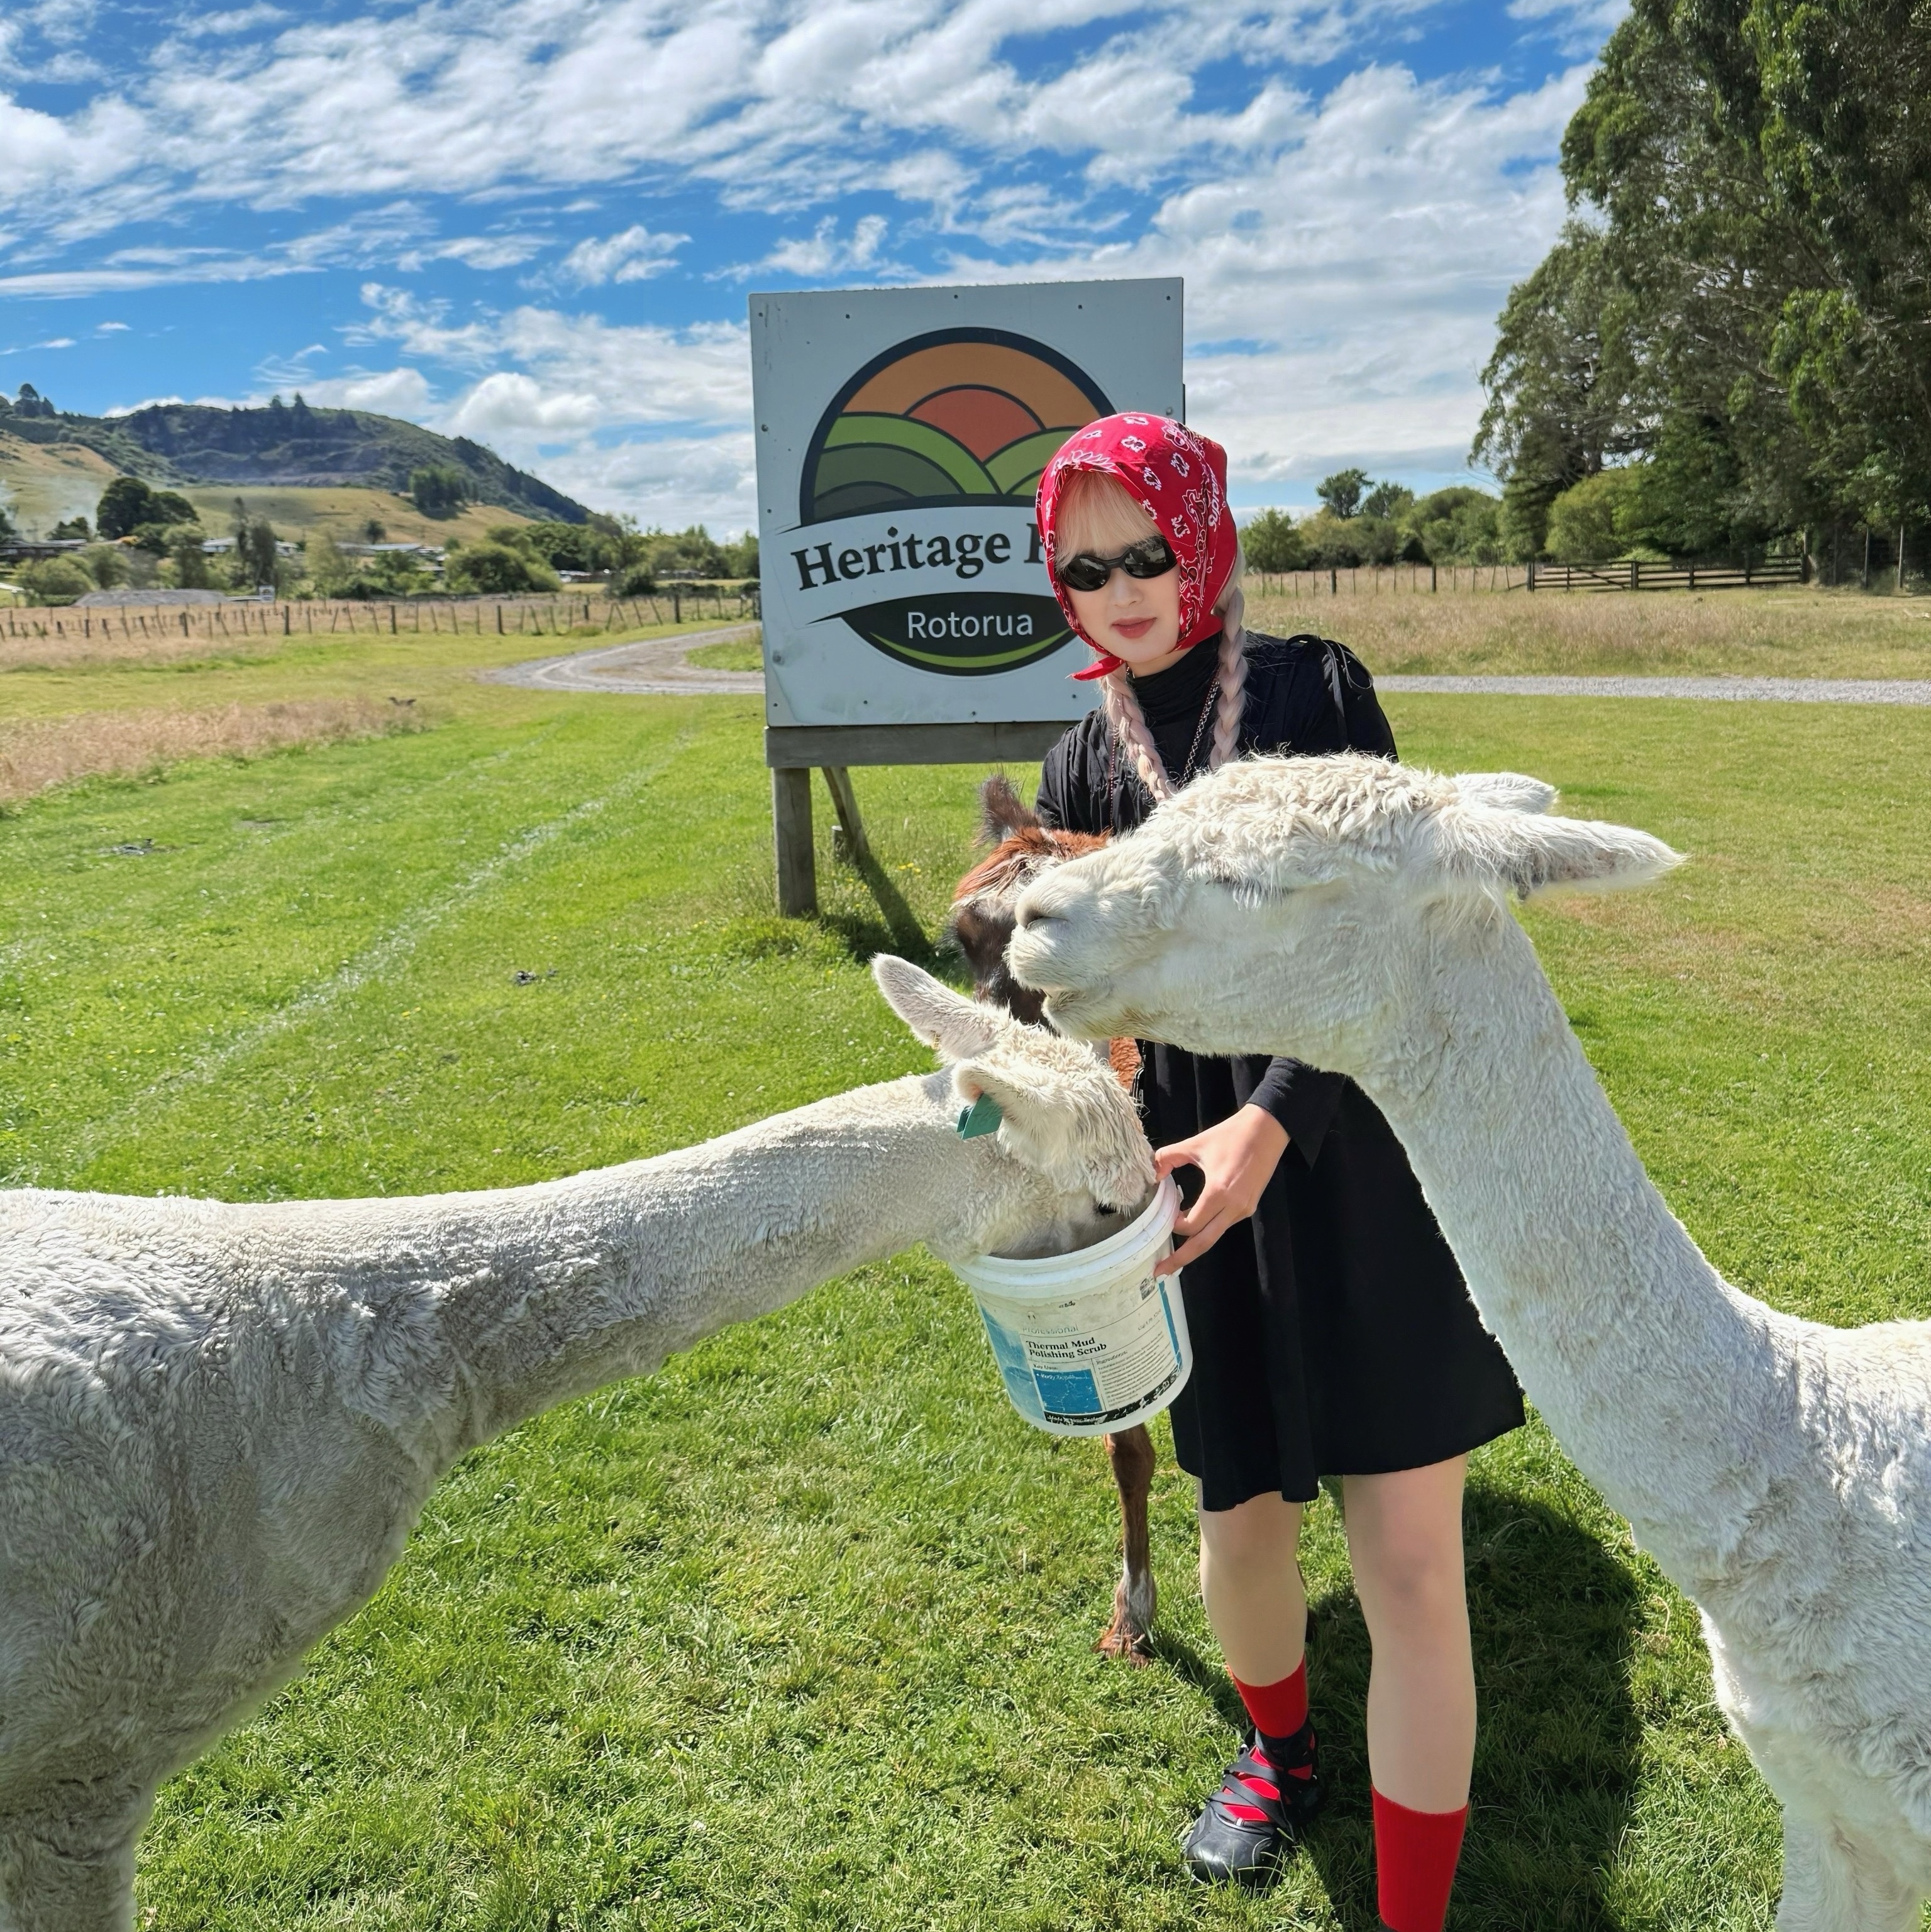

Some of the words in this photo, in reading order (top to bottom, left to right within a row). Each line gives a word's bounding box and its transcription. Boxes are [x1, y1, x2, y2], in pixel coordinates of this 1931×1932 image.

[790, 526, 1010, 592] Heritage
[907, 611, 1033, 639] Rotorua
[1026, 1340, 1068, 1350] Thermal
[1071, 1337, 1095, 1348] Mud
[1029, 1349, 1075, 1359] Polishing
[1077, 1343, 1107, 1355] Scrub
